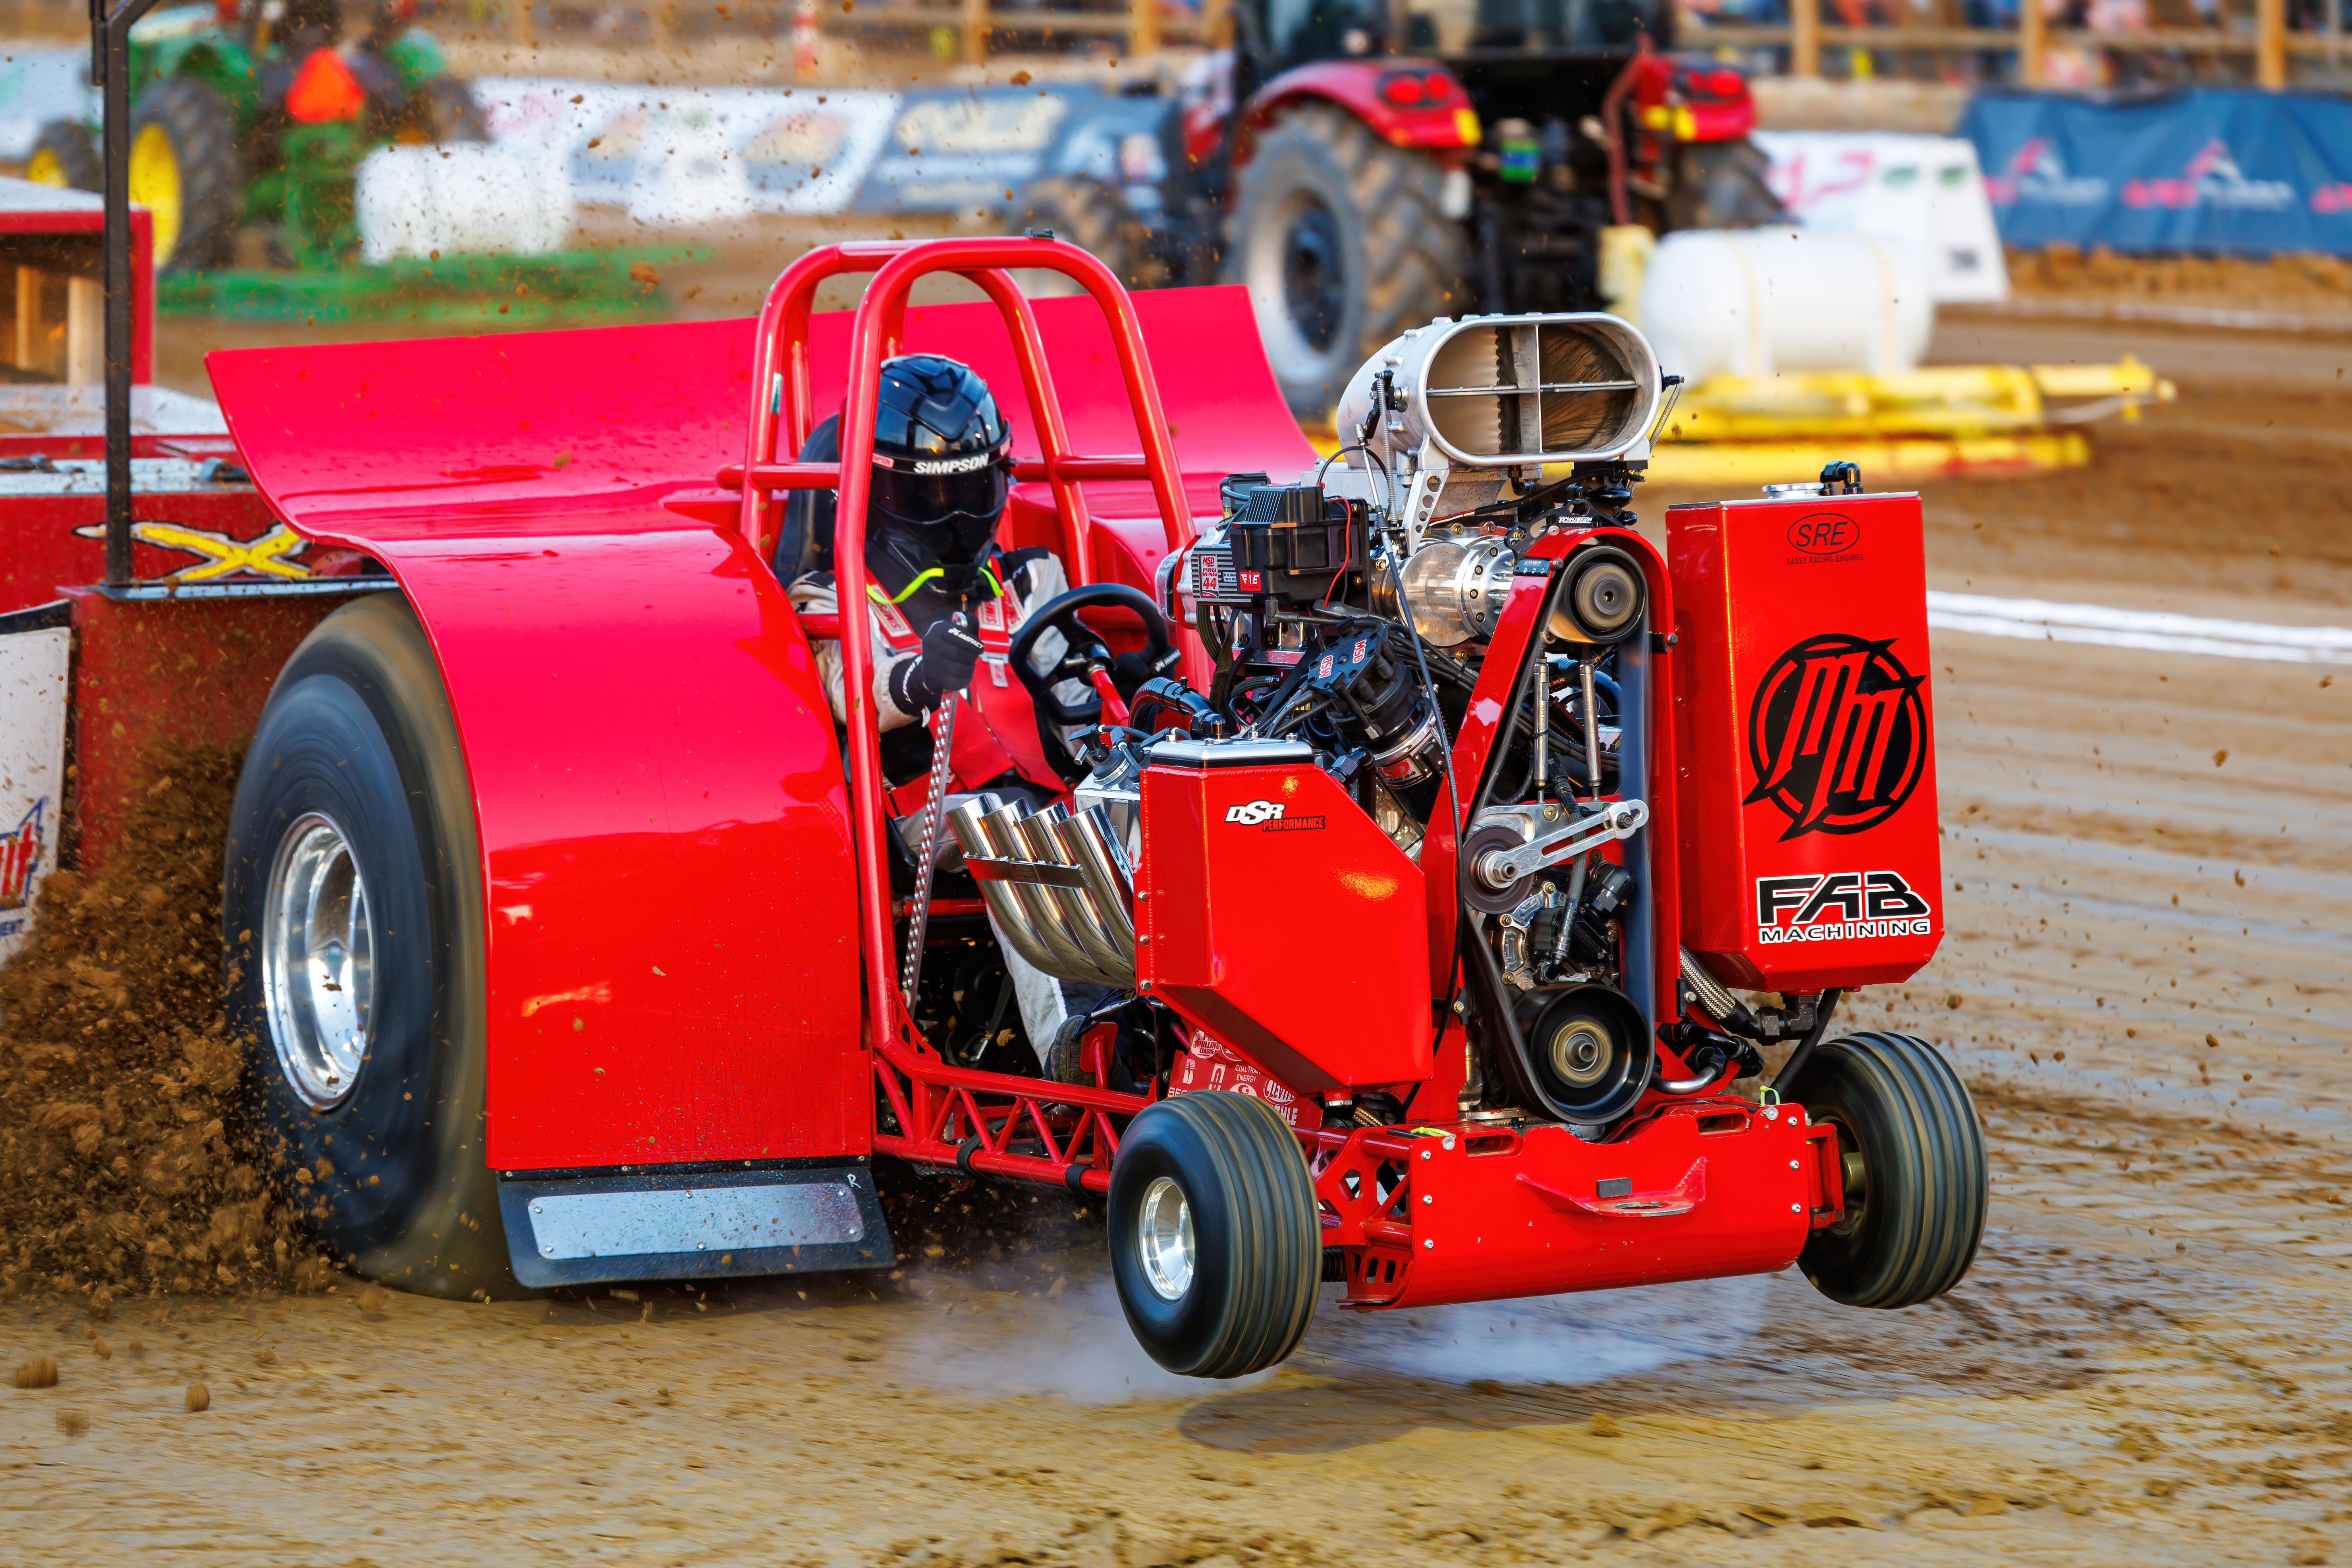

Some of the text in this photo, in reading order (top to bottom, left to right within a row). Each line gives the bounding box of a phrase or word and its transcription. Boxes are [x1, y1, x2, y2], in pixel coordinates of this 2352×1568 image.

[914, 453, 989, 474] SIMPSON
[1796, 521, 1848, 548] SRE
[1836, 554, 1864, 562] ENGINES
[1203, 578, 1217, 589] 44
[1241, 574, 1260, 584] FIE
[1353, 639, 1367, 663] MSD
[1319, 655, 1334, 679] MSD
[1225, 800, 1285, 825] DSR
[1263, 818, 1324, 831] PERFORMANCE
[1756, 870, 1931, 926] FAB
[1759, 918, 1930, 944] MACHINING
[1197, 1040, 1221, 1049] PULLING
[1236, 1074, 1256, 1083] ENERGY
[847, 1174, 861, 1188] R
